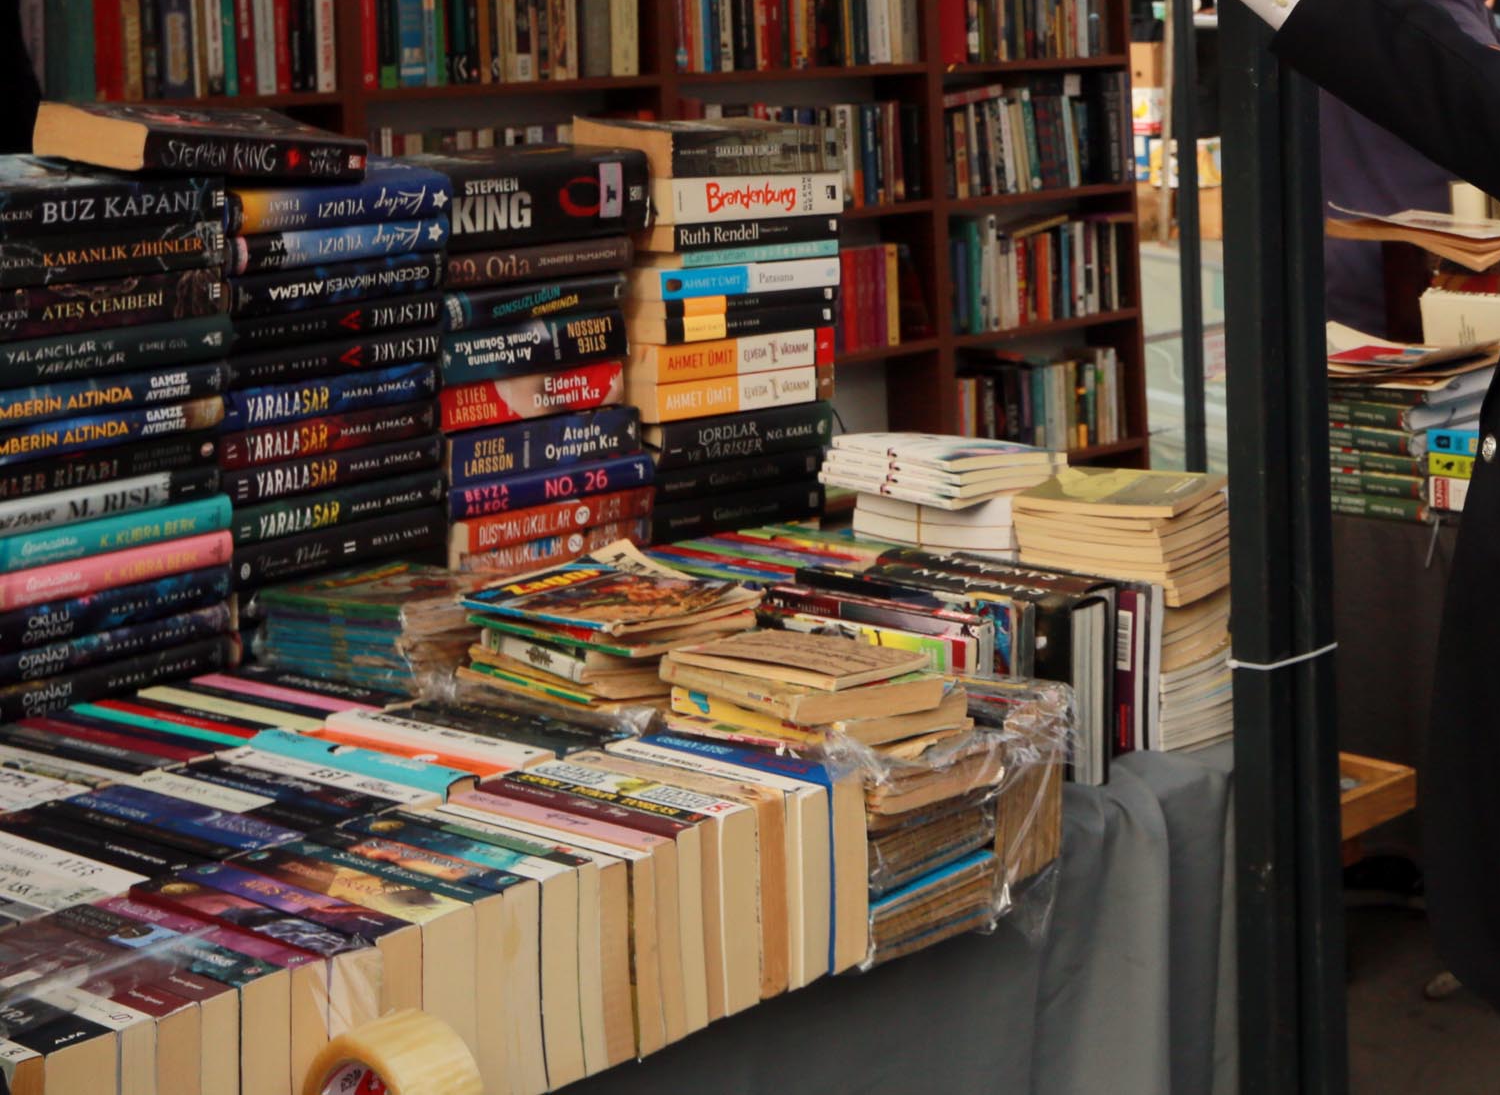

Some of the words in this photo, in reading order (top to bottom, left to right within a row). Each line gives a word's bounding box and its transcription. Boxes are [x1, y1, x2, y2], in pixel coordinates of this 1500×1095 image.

[161, 140, 229, 168] STEPHEN
[233, 143, 277, 172] KING
[465, 177, 519, 197] STEPHEN
[706, 182, 797, 213] Brandenburg
[42, 199, 95, 224] BUZ
[104, 190, 200, 218] KAPANI
[318, 195, 365, 217] YILDIZI
[451, 193, 532, 235] KING
[318, 233, 364, 254] YILDIZI
[680, 226, 711, 245] Ruth
[714, 222, 760, 242] Rendell
[43, 246, 129, 268] KARANLIK
[132, 235, 204, 257] ZİHİNLER
[538, 252, 573, 267] JENNIFER
[379, 265, 430, 285] GECENİN
[486, 252, 531, 279] Oda
[269, 280, 324, 300] AYLEMA
[685, 277, 718, 290] AHMET
[42, 301, 87, 323] ATEŞ
[90, 290, 164, 318] ÇEMBERİ
[531, 294, 579, 316] SINIRINDA
[567, 316, 612, 339] LARSSON
[455, 341, 472, 354] Kız
[474, 335, 505, 351] Sokan
[505, 330, 541, 348] Çomak
[578, 334, 607, 355] STIEG
[6, 340, 97, 366] YALANCILAR
[468, 349, 508, 366] Kovanına
[510, 346, 531, 361] Arı
[667, 349, 704, 371] AHMET
[708, 344, 734, 367] ÜMİT
[150, 372, 189, 388] GAMZE
[543, 373, 588, 391] Ejderha
[67, 387, 134, 410] ALTINDA
[145, 383, 191, 401] AYDENİZ
[246, 386, 330, 421] YARALASAR
[342, 384, 376, 399] MARAL
[378, 379, 417, 395] ATMACA
[456, 386, 488, 406] STIEG
[533, 388, 579, 408] Dövmeli
[581, 385, 600, 401] Kız
[665, 388, 703, 410] AHMET
[707, 381, 734, 404] ÜMİT
[145, 406, 184, 422] GAMZE
[449, 403, 499, 426] LARSSON
[63, 421, 129, 447] ALTINDA
[141, 417, 187, 436] AYDENİZ
[563, 423, 601, 442] Ateşle
[698, 421, 759, 446] LORDLAR
[246, 423, 329, 462] YARALASAR
[340, 422, 372, 438] MARAL
[374, 415, 415, 433] ATMACA
[474, 438, 506, 458] STIEG
[545, 439, 596, 461] Oynayan
[599, 434, 619, 451] Kız
[256, 458, 338, 497] YARALASAR
[350, 458, 383, 473] MARAL
[385, 450, 422, 466] ATMACA
[464, 455, 514, 477] LARSSON
[464, 484, 509, 503] BEYZA
[544, 474, 579, 498] NO.
[583, 468, 609, 491] 26
[258, 500, 341, 538] YARALASAR
[351, 498, 383, 513] MARAL
[386, 490, 423, 506] ATMACA
[522, 508, 571, 538] OKULLAR
[164, 518, 197, 535] BERK
[166, 551, 199, 566] BERK
[111, 597, 149, 614] MARAL
[152, 587, 203, 607] ATMACA
[106, 635, 145, 652] MARAL
[148, 625, 198, 644] ATMACA
[108, 669, 146, 688] MARAL
[148, 658, 198, 678] ATMACA
[54, 1030, 87, 1045] ALFA
